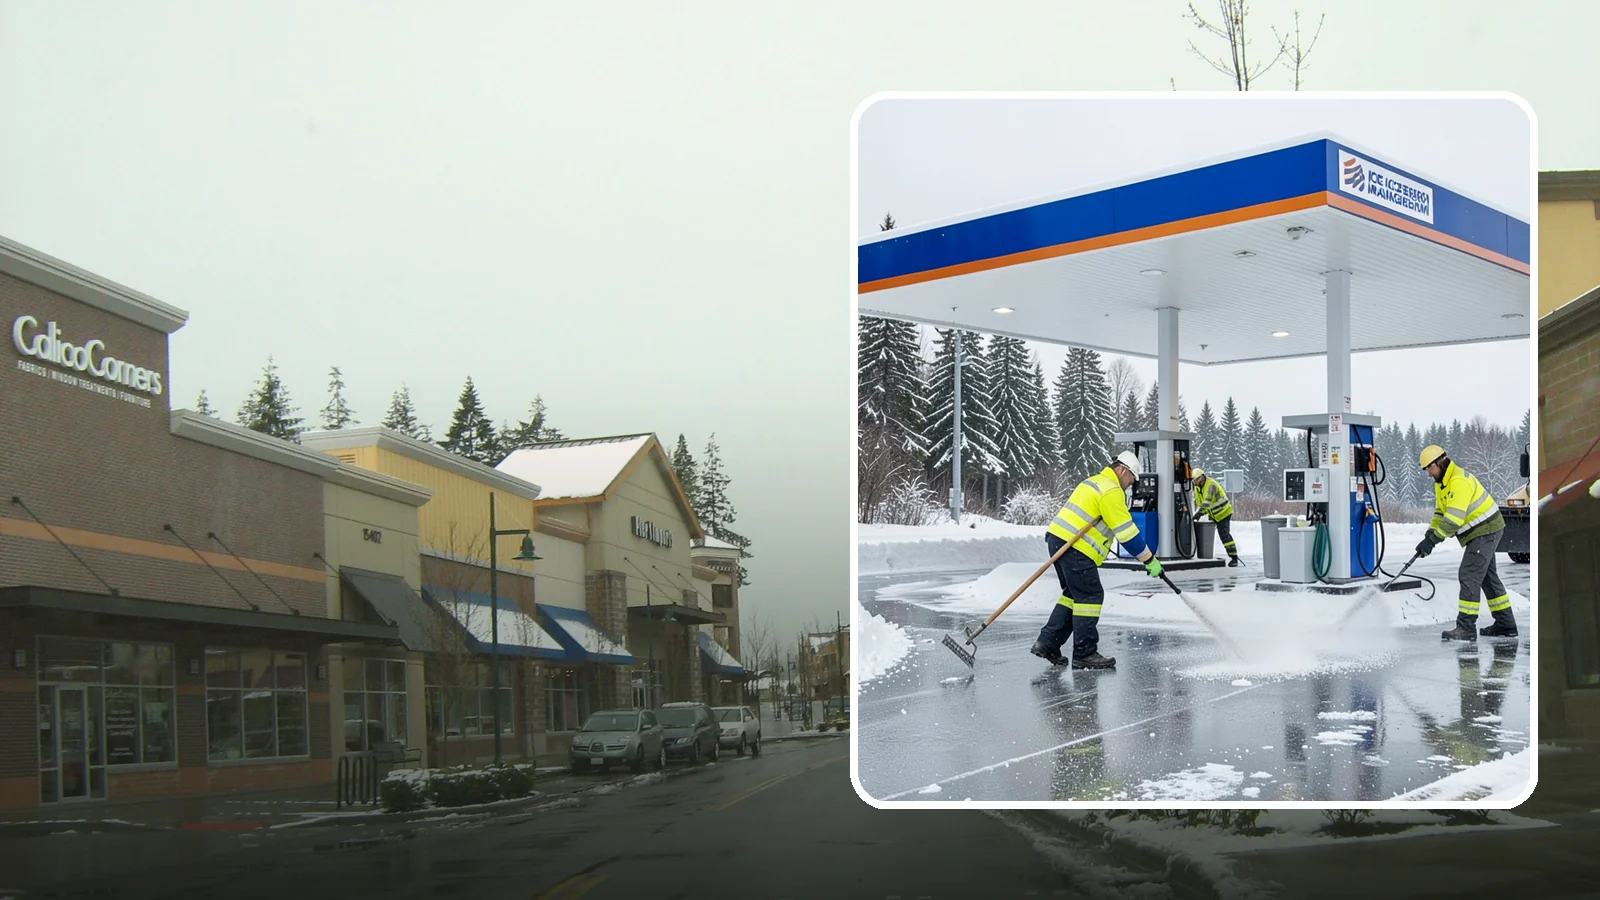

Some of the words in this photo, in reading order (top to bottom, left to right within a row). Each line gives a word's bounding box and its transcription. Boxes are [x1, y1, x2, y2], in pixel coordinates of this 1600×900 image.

[16, 360, 47, 378] FABRICS
[51, 369, 78, 387] WINDOW
[78, 378, 116, 398] TREATMENTS
[120, 391, 151, 409] FURNITURE
